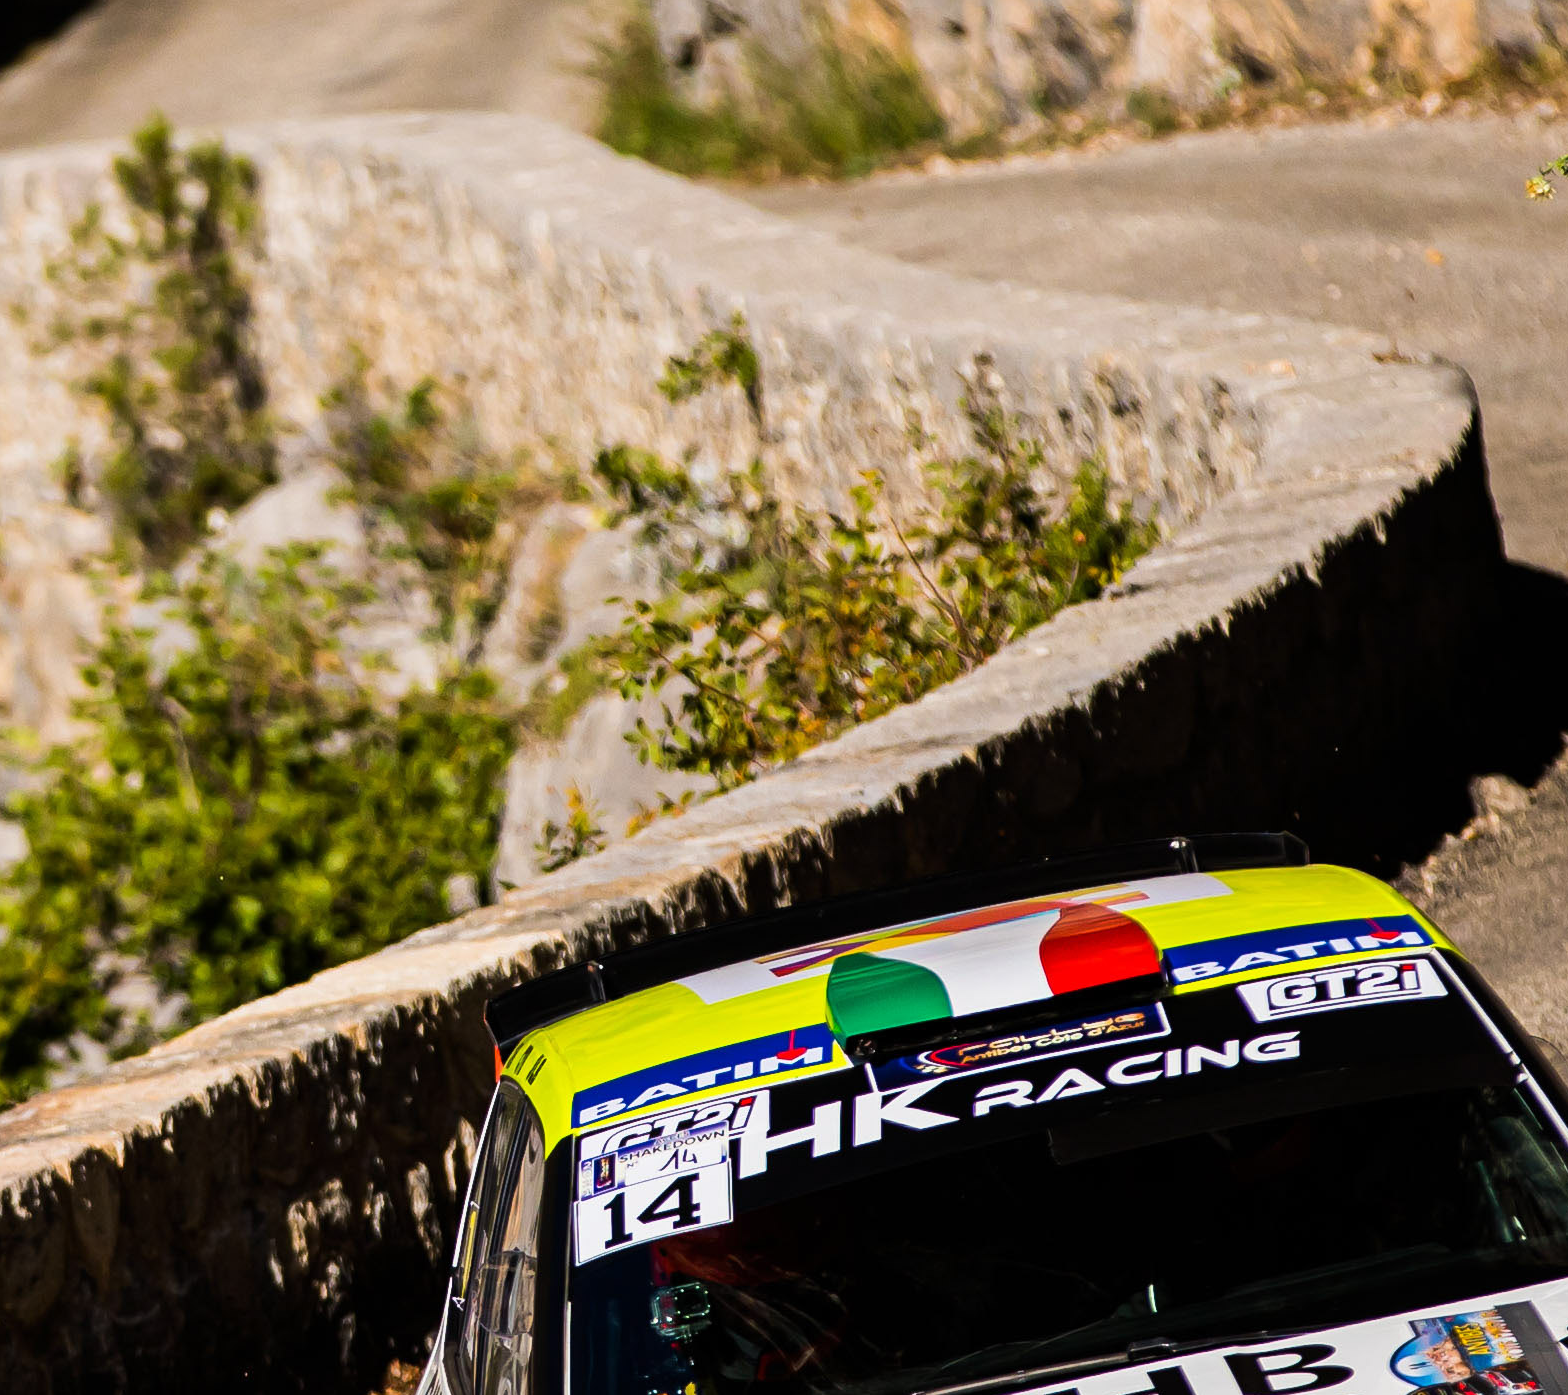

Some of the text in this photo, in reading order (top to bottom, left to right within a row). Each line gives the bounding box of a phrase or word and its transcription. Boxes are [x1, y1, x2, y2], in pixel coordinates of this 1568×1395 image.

[1172, 931, 1425, 983] BATIM
[1269, 963, 1419, 1008] GT2i
[579, 1046, 823, 1125] BATIM
[739, 1031, 1301, 1180] HK RACING
[617, 1129, 725, 1163] SHAKEDOWN
[659, 1148, 698, 1172] 14
[604, 1173, 700, 1250] 14
